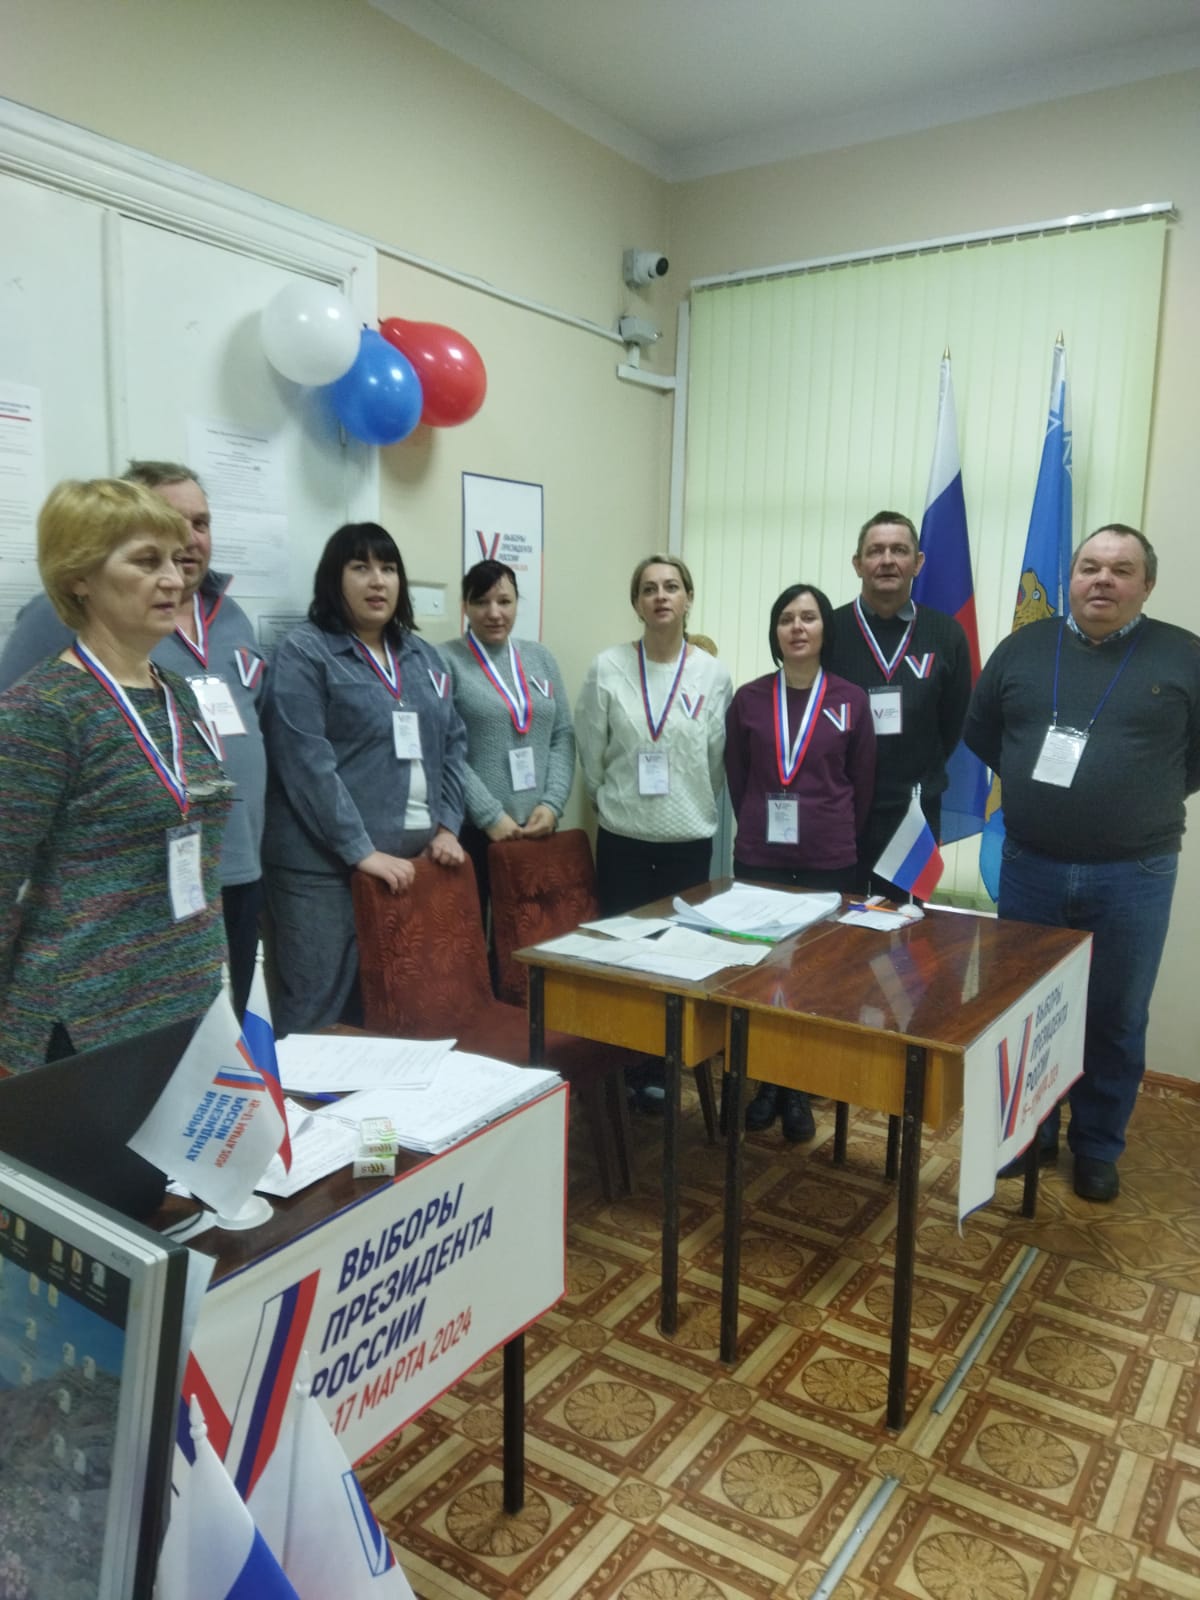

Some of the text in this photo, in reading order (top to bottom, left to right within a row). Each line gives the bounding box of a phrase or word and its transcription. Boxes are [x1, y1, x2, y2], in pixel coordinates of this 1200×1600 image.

[320, 1206, 494, 1355] ПРЕЗИДЕНТА
[337, 1182, 464, 1295] ВЫБОРЫ
[309, 1296, 427, 1399] РОССИИ
[358, 1341, 427, 1421] МАРТА
[428, 1305, 472, 1365] 2024
